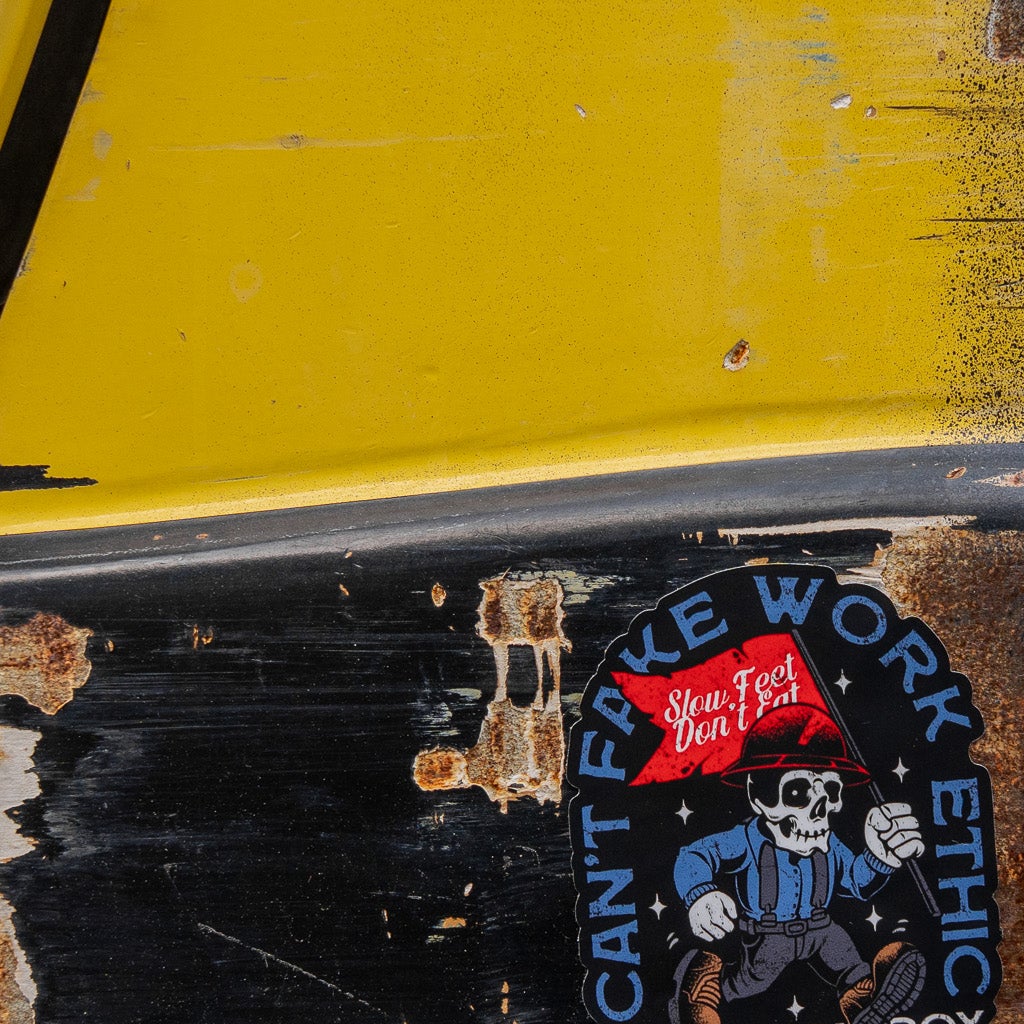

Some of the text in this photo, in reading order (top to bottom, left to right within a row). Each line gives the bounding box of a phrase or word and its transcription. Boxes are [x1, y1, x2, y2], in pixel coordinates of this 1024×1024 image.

[664, 652, 798, 724] Slow Feet
[672, 701, 749, 753] Don't
[578, 575, 991, 1022] CAN'T FAKE WORK ETHIC
